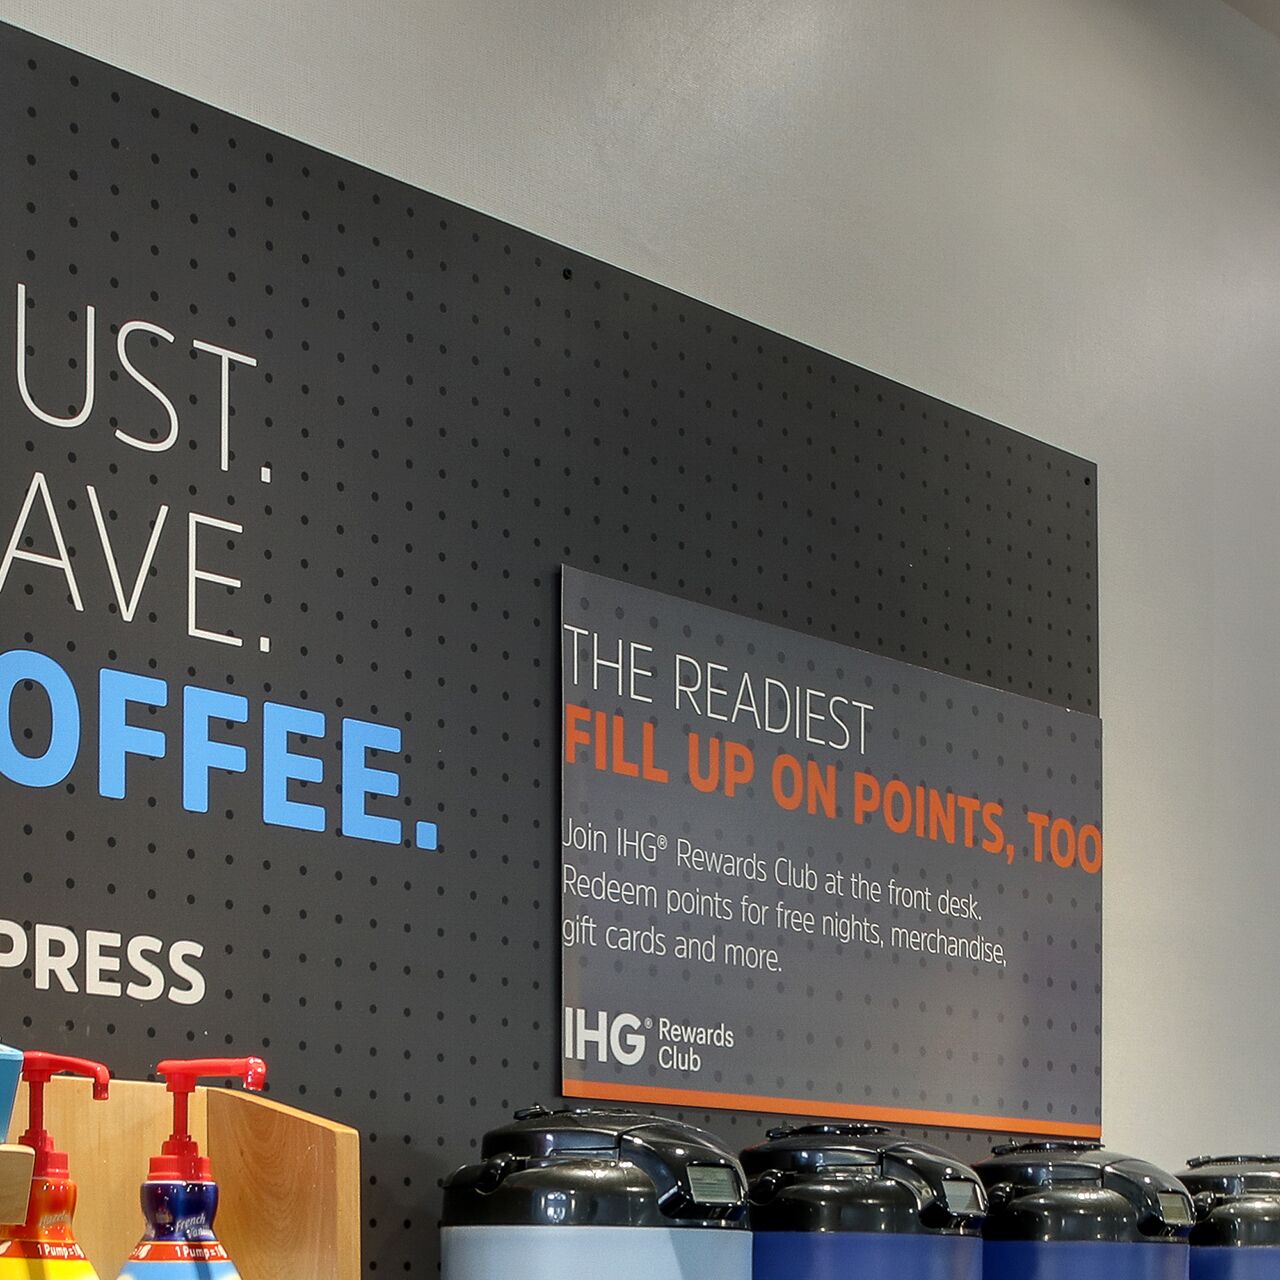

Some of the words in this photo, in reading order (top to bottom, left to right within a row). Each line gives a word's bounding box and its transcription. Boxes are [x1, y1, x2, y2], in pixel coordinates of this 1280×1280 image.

[563, 624, 653, 703] THE
[675, 654, 874, 754] READIEST
[565, 703, 669, 783] FILL
[688, 732, 754, 797] UP
[771, 754, 836, 819] ON
[853, 773, 1015, 865] POINTS,
[1027, 811, 1102, 874] TOO
[562, 819, 607, 854] Join
[677, 838, 767, 882] Rewards
[774, 857, 818, 891] Club
[824, 870, 844, 896] at
[850, 872, 882, 903] the
[888, 879, 932, 912] front
[937, 889, 982, 921] desk.
[562, 914, 597, 947] gift
[605, 925, 667, 956] cards
[674, 934, 716, 963] and
[724, 942, 782, 972] more.
[563, 864, 657, 908] Redeem
[667, 887, 733, 921] points
[740, 895, 769, 926] for
[775, 901, 815, 934] free
[822, 911, 884, 949] nights,
[891, 926, 1007, 968] merchandise,
[658, 1045, 701, 1072] Club
[659, 1017, 734, 1048] Rewards
[175, 1212, 206, 1233] French
